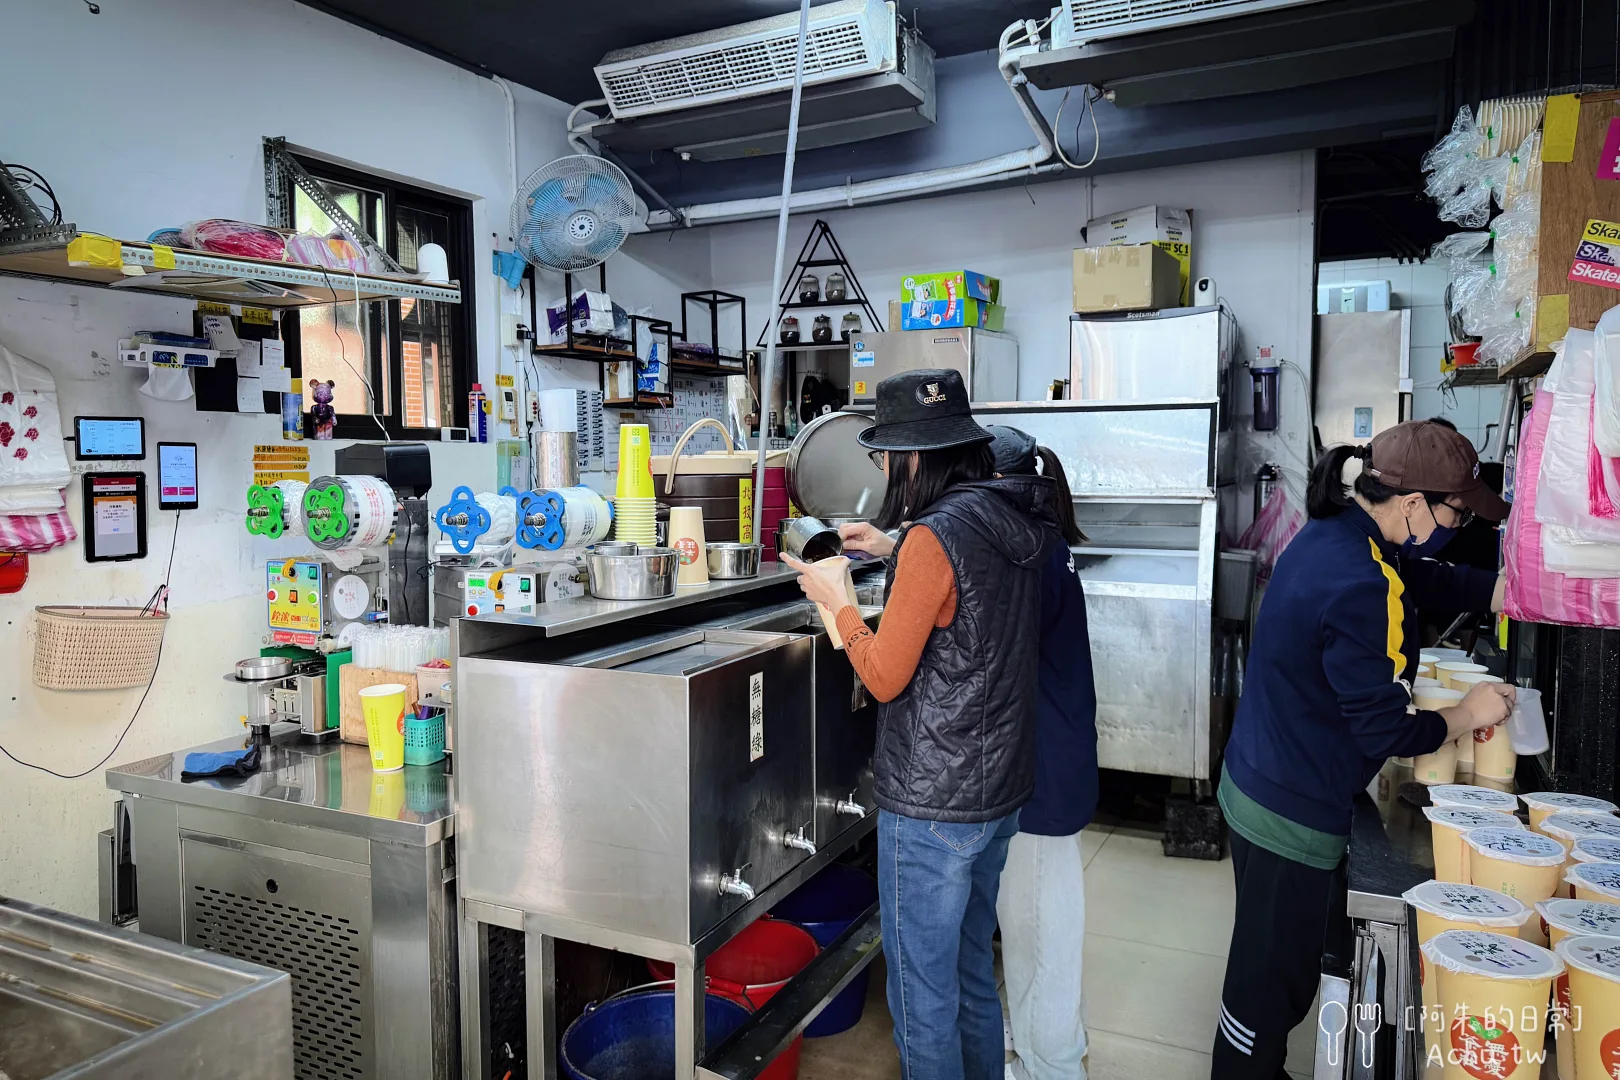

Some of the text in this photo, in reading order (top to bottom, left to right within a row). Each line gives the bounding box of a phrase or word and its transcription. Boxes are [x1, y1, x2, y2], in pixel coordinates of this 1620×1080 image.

[1587, 222, 1620, 239] Ska
[1173, 243, 1183, 253] SC
[1126, 311, 1160, 319] Scotsman
[857, 381, 864, 391] 3
[923, 394, 947, 404] GUCCI
